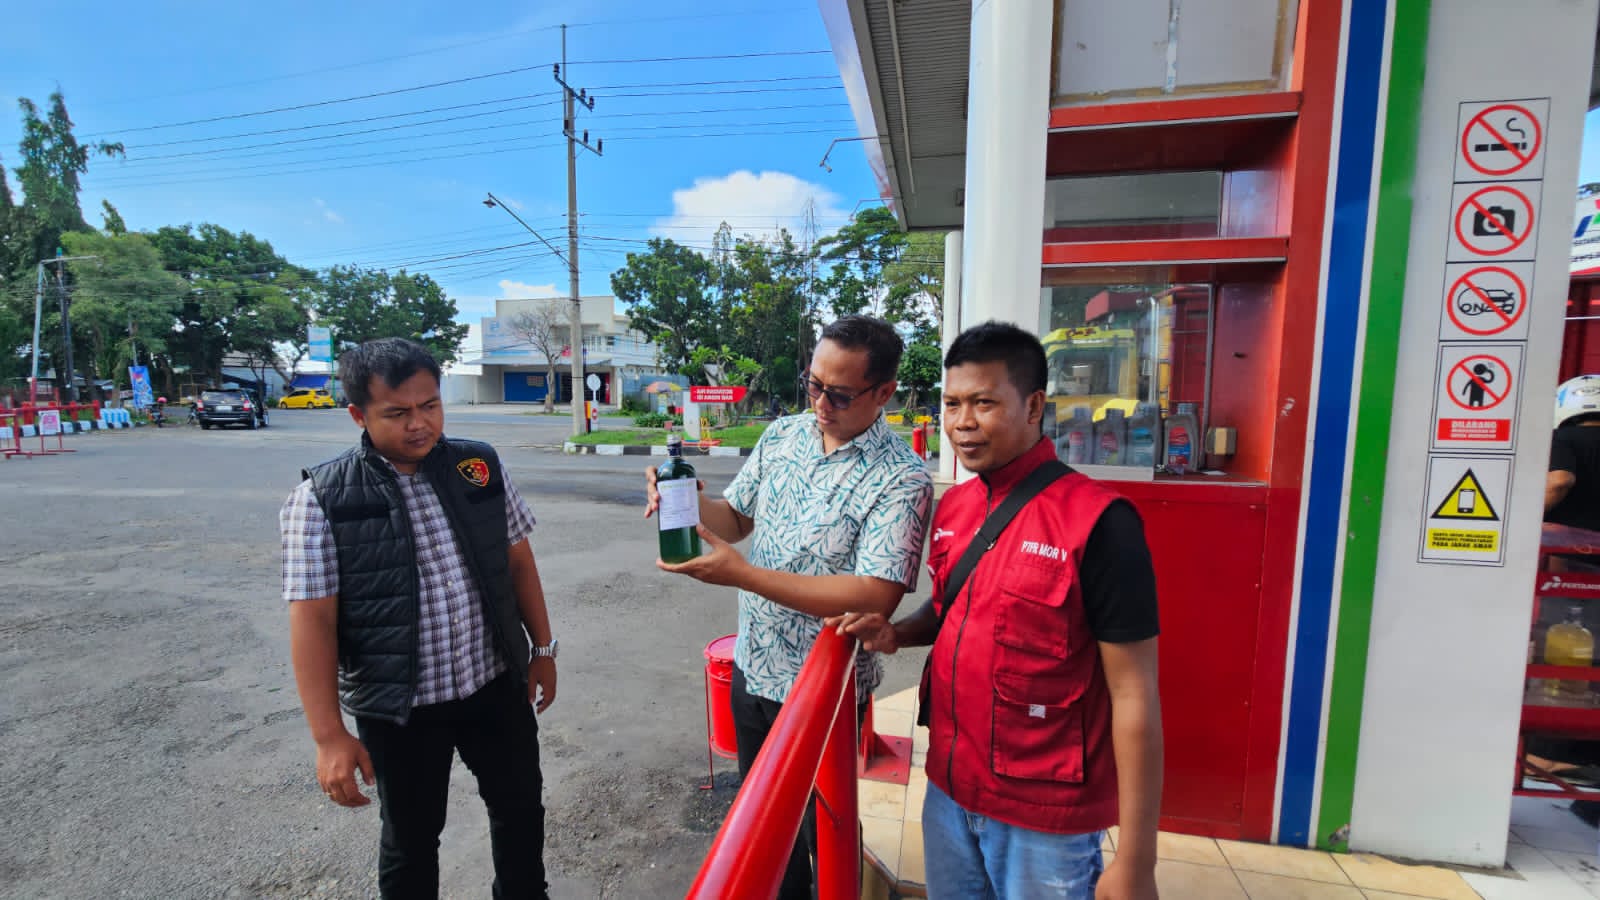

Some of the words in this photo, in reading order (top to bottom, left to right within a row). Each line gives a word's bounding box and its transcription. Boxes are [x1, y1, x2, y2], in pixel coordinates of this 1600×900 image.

[1451, 420, 1496, 428] DILARANG
[1038, 543, 1059, 560] MOR
[1061, 547, 1068, 562] V
